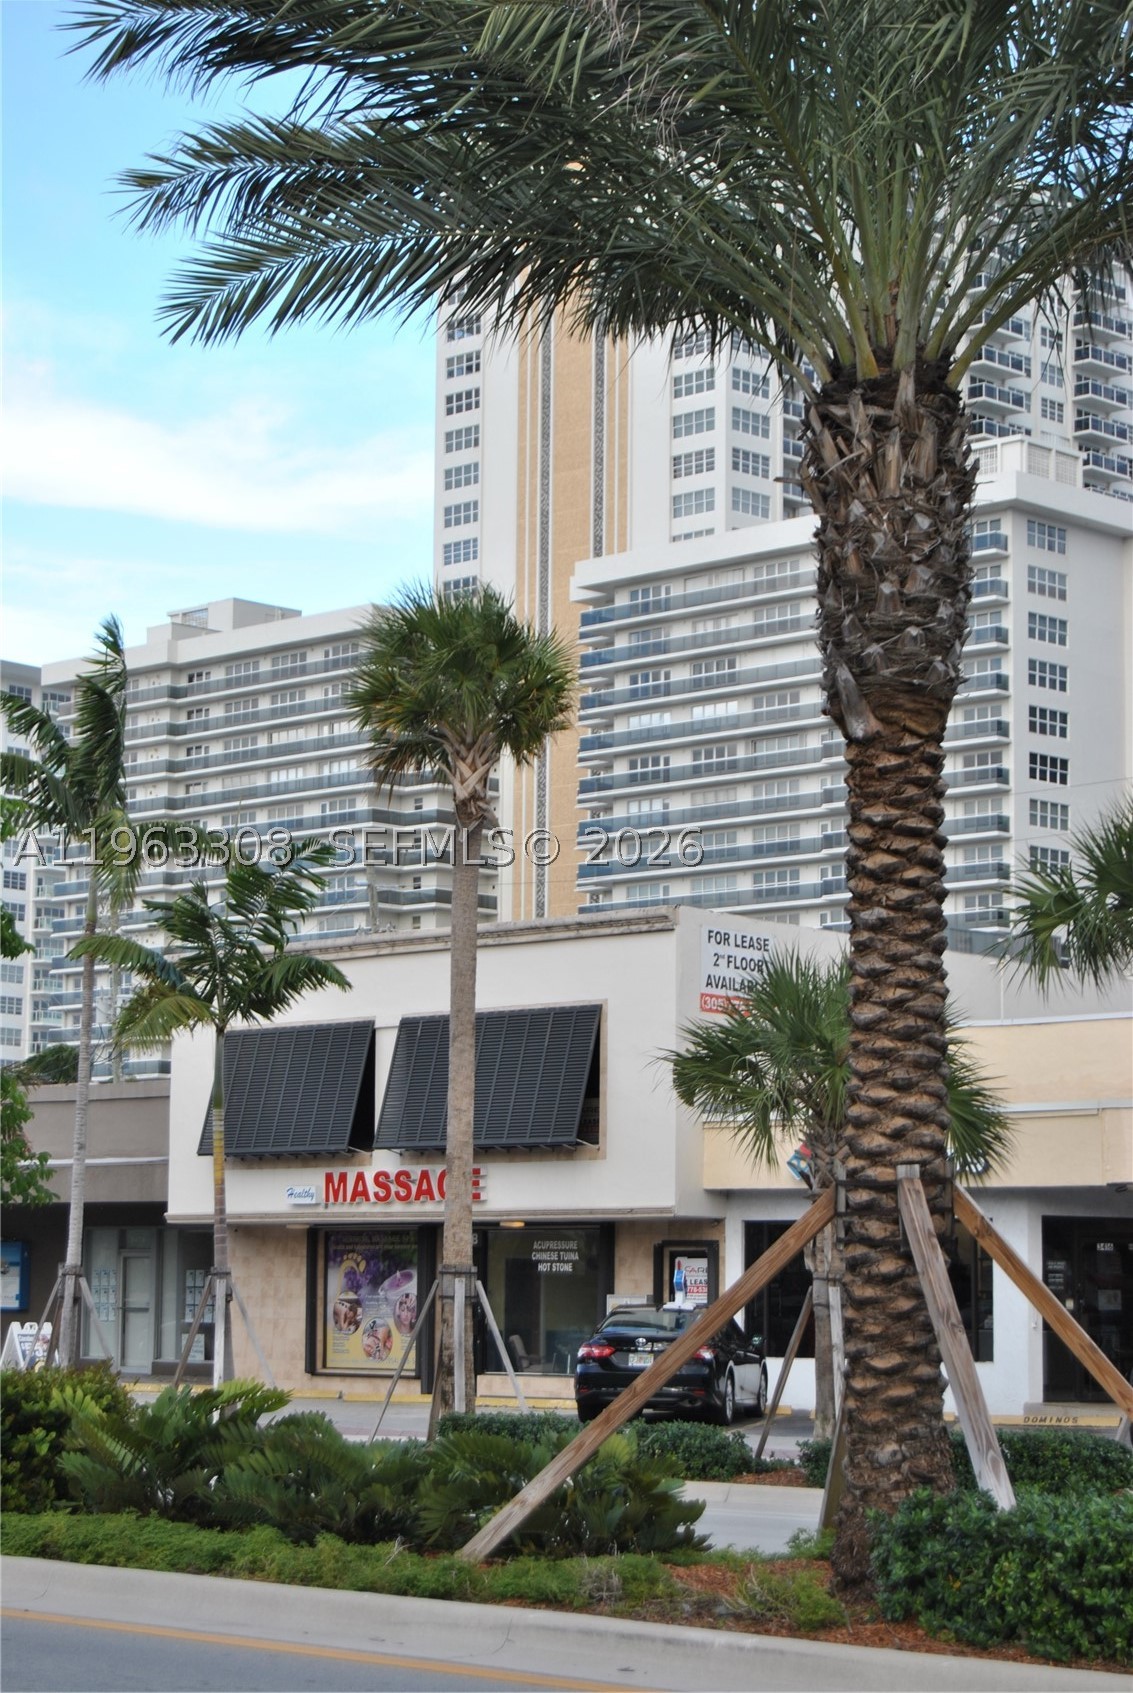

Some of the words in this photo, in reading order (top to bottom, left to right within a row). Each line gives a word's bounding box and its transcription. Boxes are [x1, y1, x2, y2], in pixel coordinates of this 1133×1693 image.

[707, 929, 731, 947] FOR
[734, 933, 770, 952] LEASE
[727, 955, 765, 975] FLOOR
[286, 1187, 316, 1201] Healthy
[533, 1240, 578, 1250] ACUPRESSURE
[531, 1251, 559, 1260] CHINESE
[559, 1251, 580, 1260] TUINA
[537, 1262, 551, 1272] HOT
[552, 1262, 573, 1272] STONE
[1023, 1416, 1079, 1424] DOMINOS
